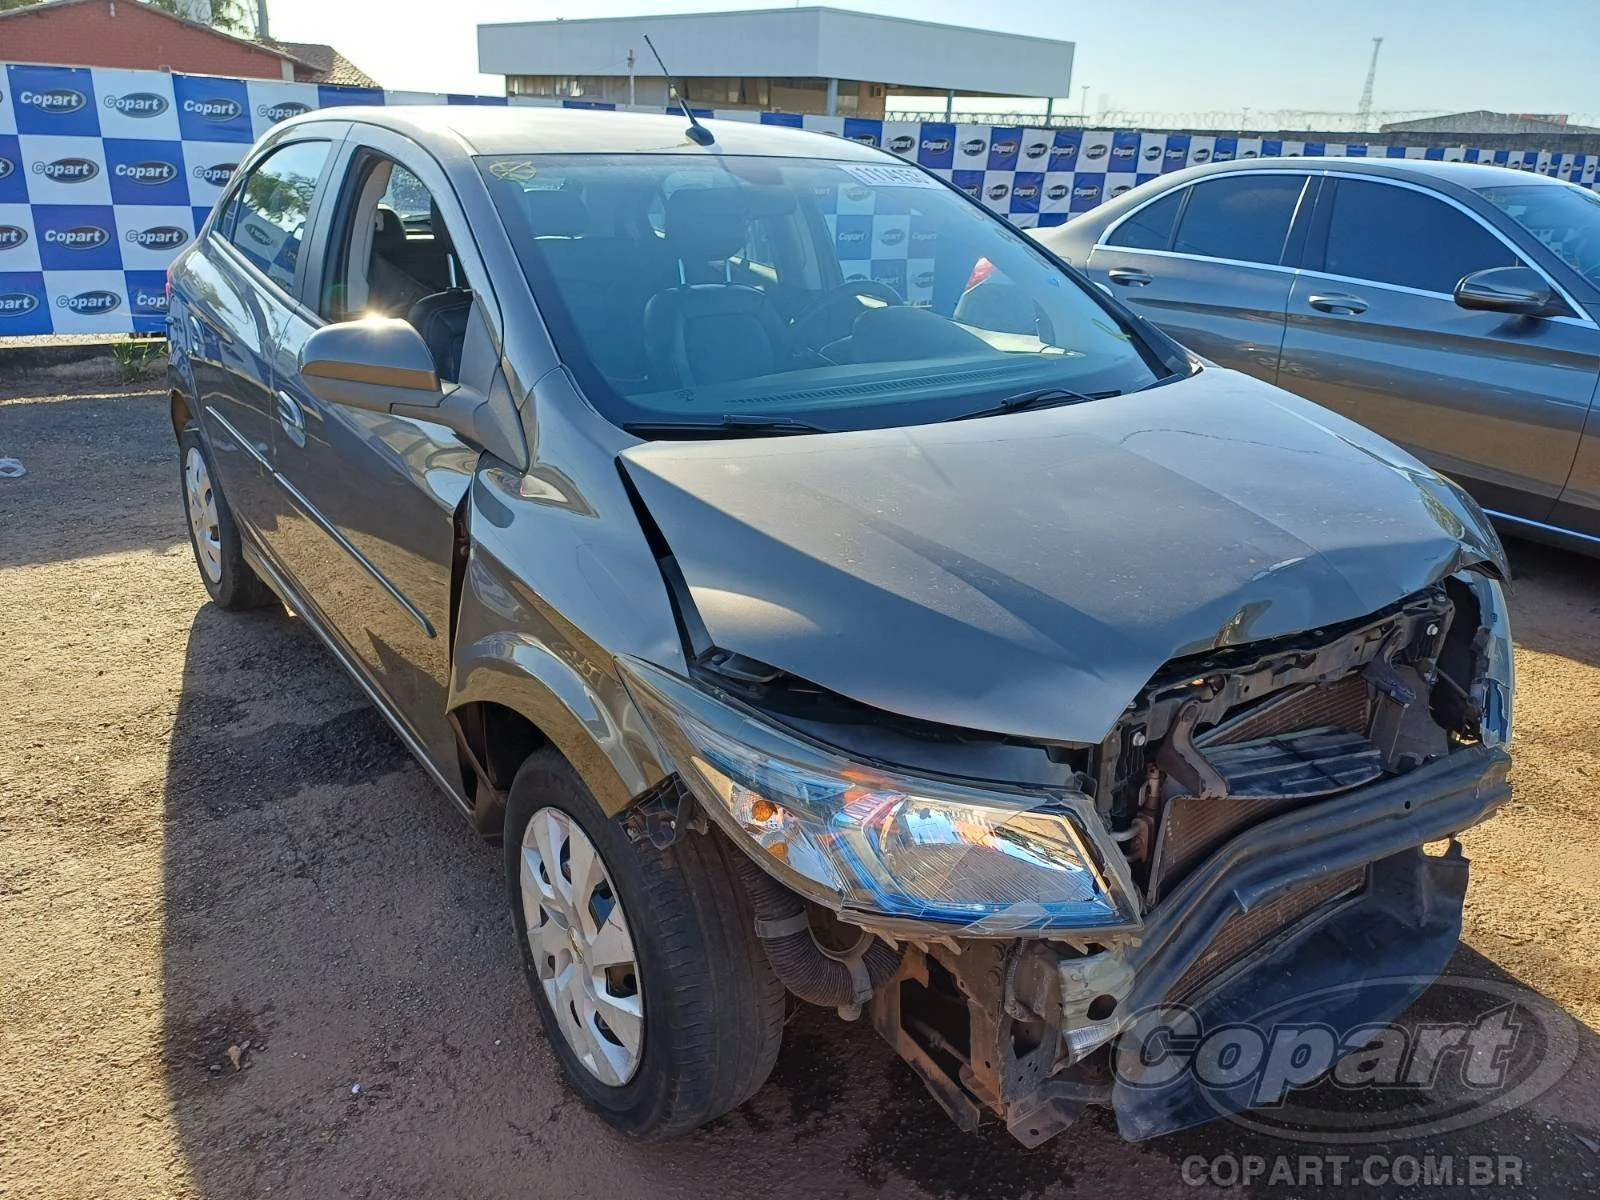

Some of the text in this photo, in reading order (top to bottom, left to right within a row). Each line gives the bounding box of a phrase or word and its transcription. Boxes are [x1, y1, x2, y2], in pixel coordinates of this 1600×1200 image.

[20, 91, 78, 107] Copart
[104, 95, 158, 111] Copart
[183, 99, 235, 115] Copart
[921, 140, 948, 151] Copart
[991, 143, 1015, 154] Copart
[1050, 145, 1074, 155] Copart
[1112, 147, 1136, 158] Copart
[1165, 149, 1185, 158] Copart
[32, 161, 90, 179] Copart
[115, 164, 170, 179] Copart
[193, 166, 234, 181] Copa
[1013, 187, 1036, 197] Copart
[1074, 187, 1097, 198] Copart
[45, 230, 101, 244] Copart
[126, 230, 179, 245] Copart
[56, 295, 113, 310] Copart
